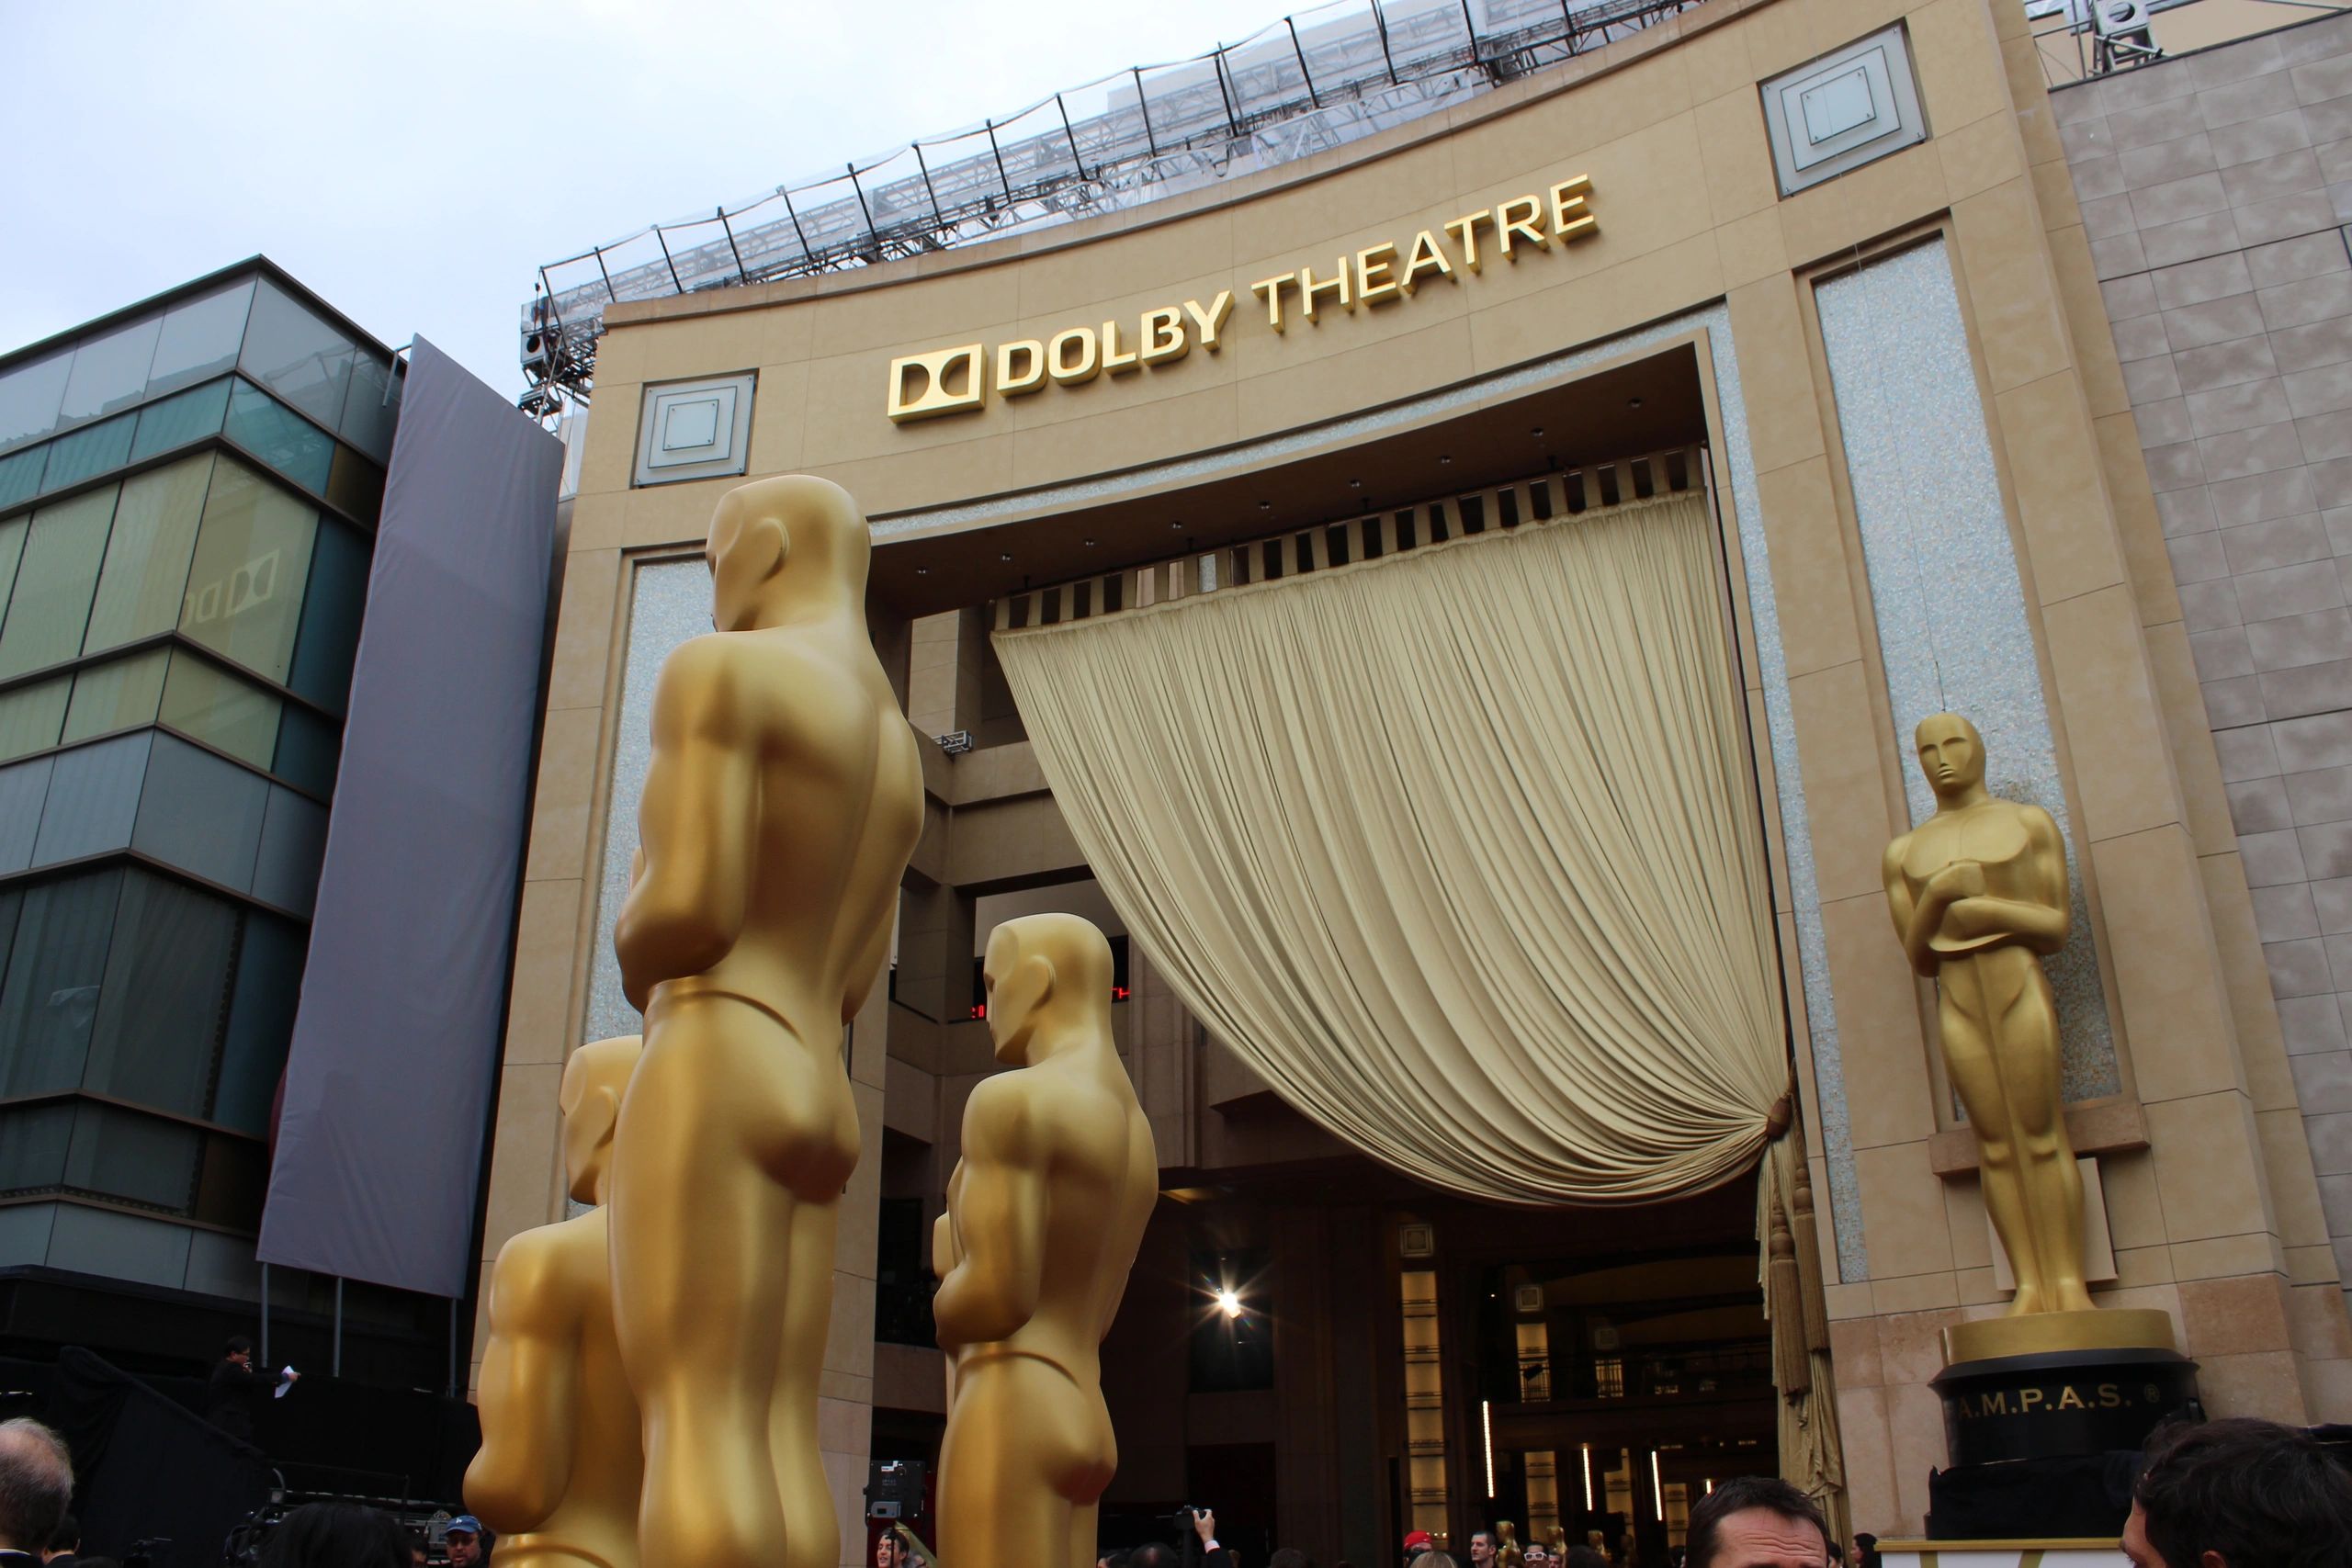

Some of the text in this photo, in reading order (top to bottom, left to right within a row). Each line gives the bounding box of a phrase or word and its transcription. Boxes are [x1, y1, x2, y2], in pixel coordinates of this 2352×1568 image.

[997, 174, 1599, 397] DOLBY THEATRE
[1959, 1384, 2132, 1418] A.M.P.A.S.
